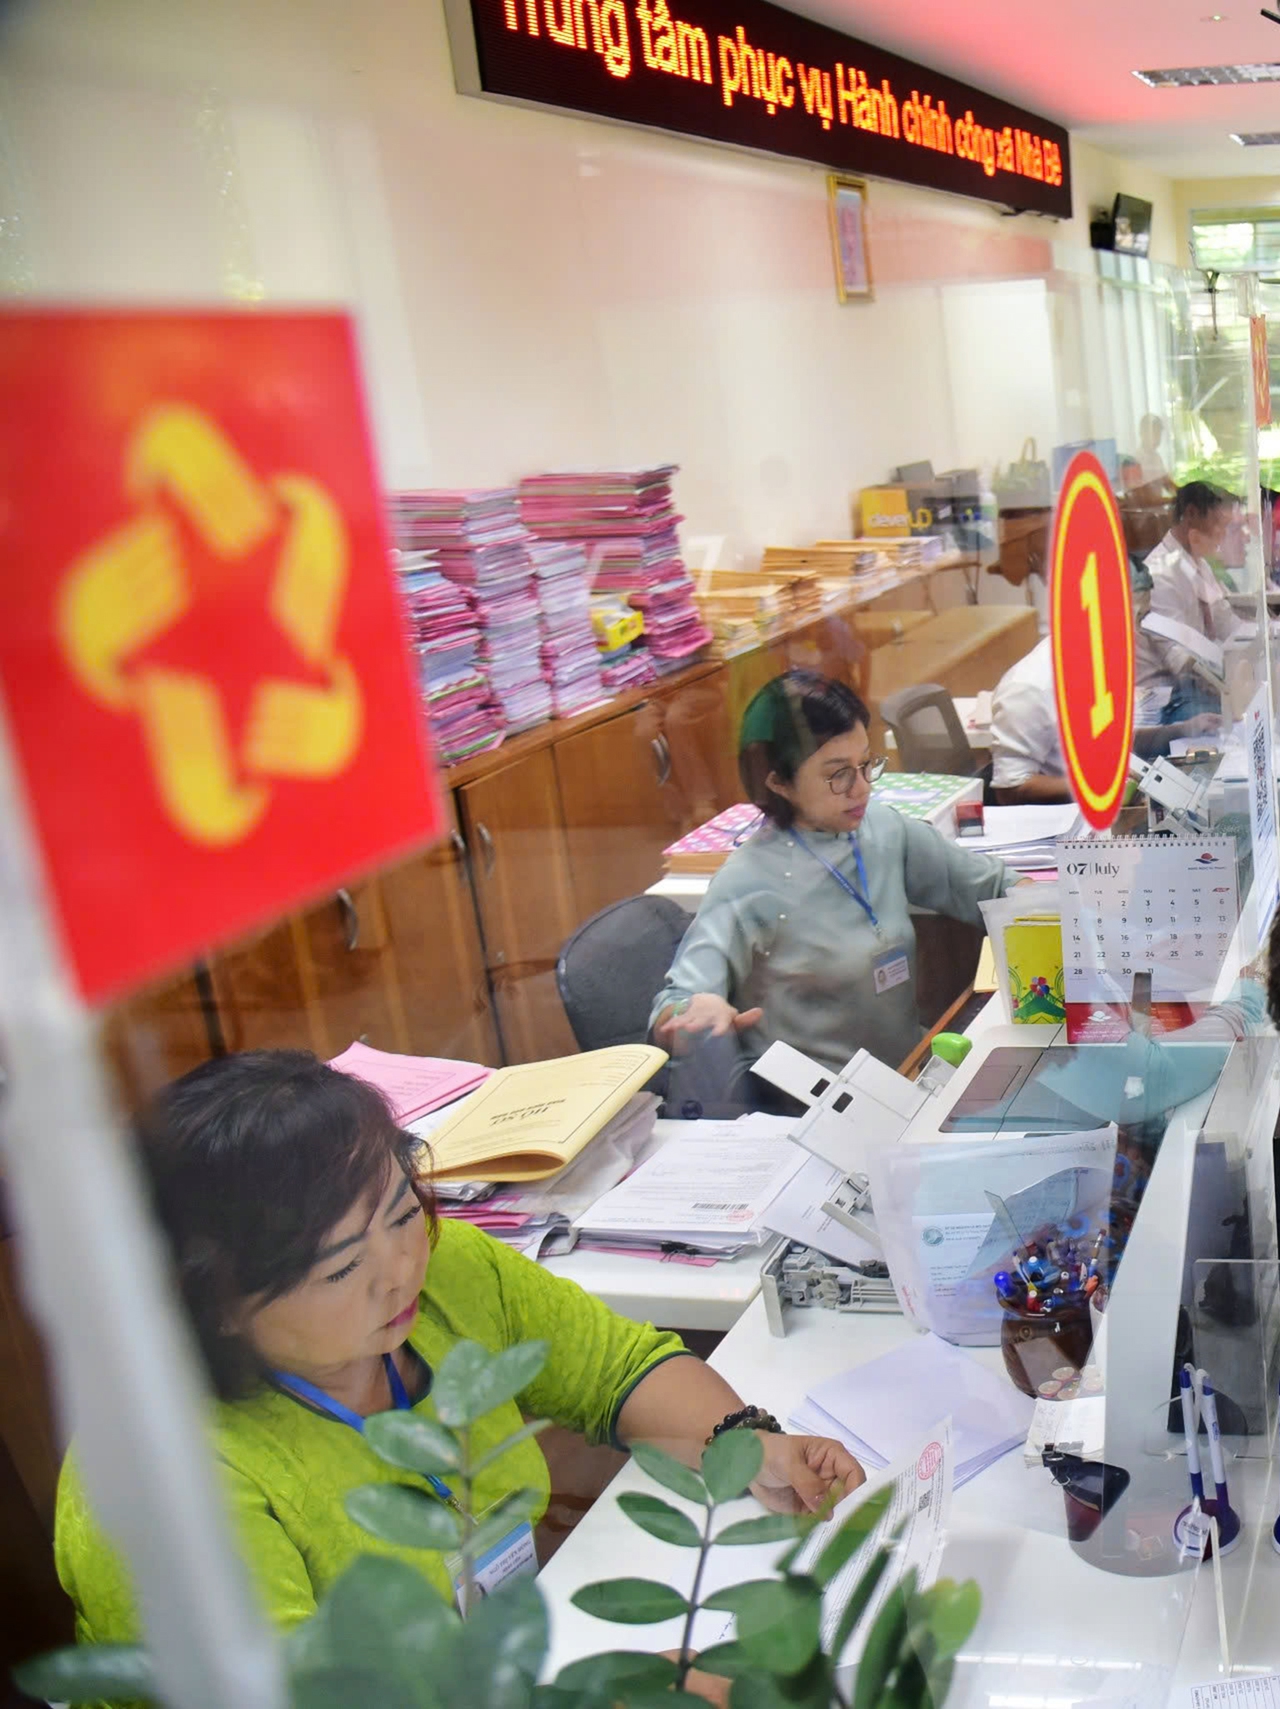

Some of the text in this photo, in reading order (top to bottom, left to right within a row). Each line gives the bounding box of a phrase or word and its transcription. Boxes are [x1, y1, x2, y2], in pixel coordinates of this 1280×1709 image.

[718, 26, 794, 115] phục
[797, 63, 833, 130] vụ
[835, 63, 900, 139] Hành
[902, 90, 954, 155] chính
[954, 111, 995, 177] công
[1014, 128, 1043, 182] Nhà
[1080, 551, 1115, 739] 1
[1066, 861, 1121, 878] 07 July
